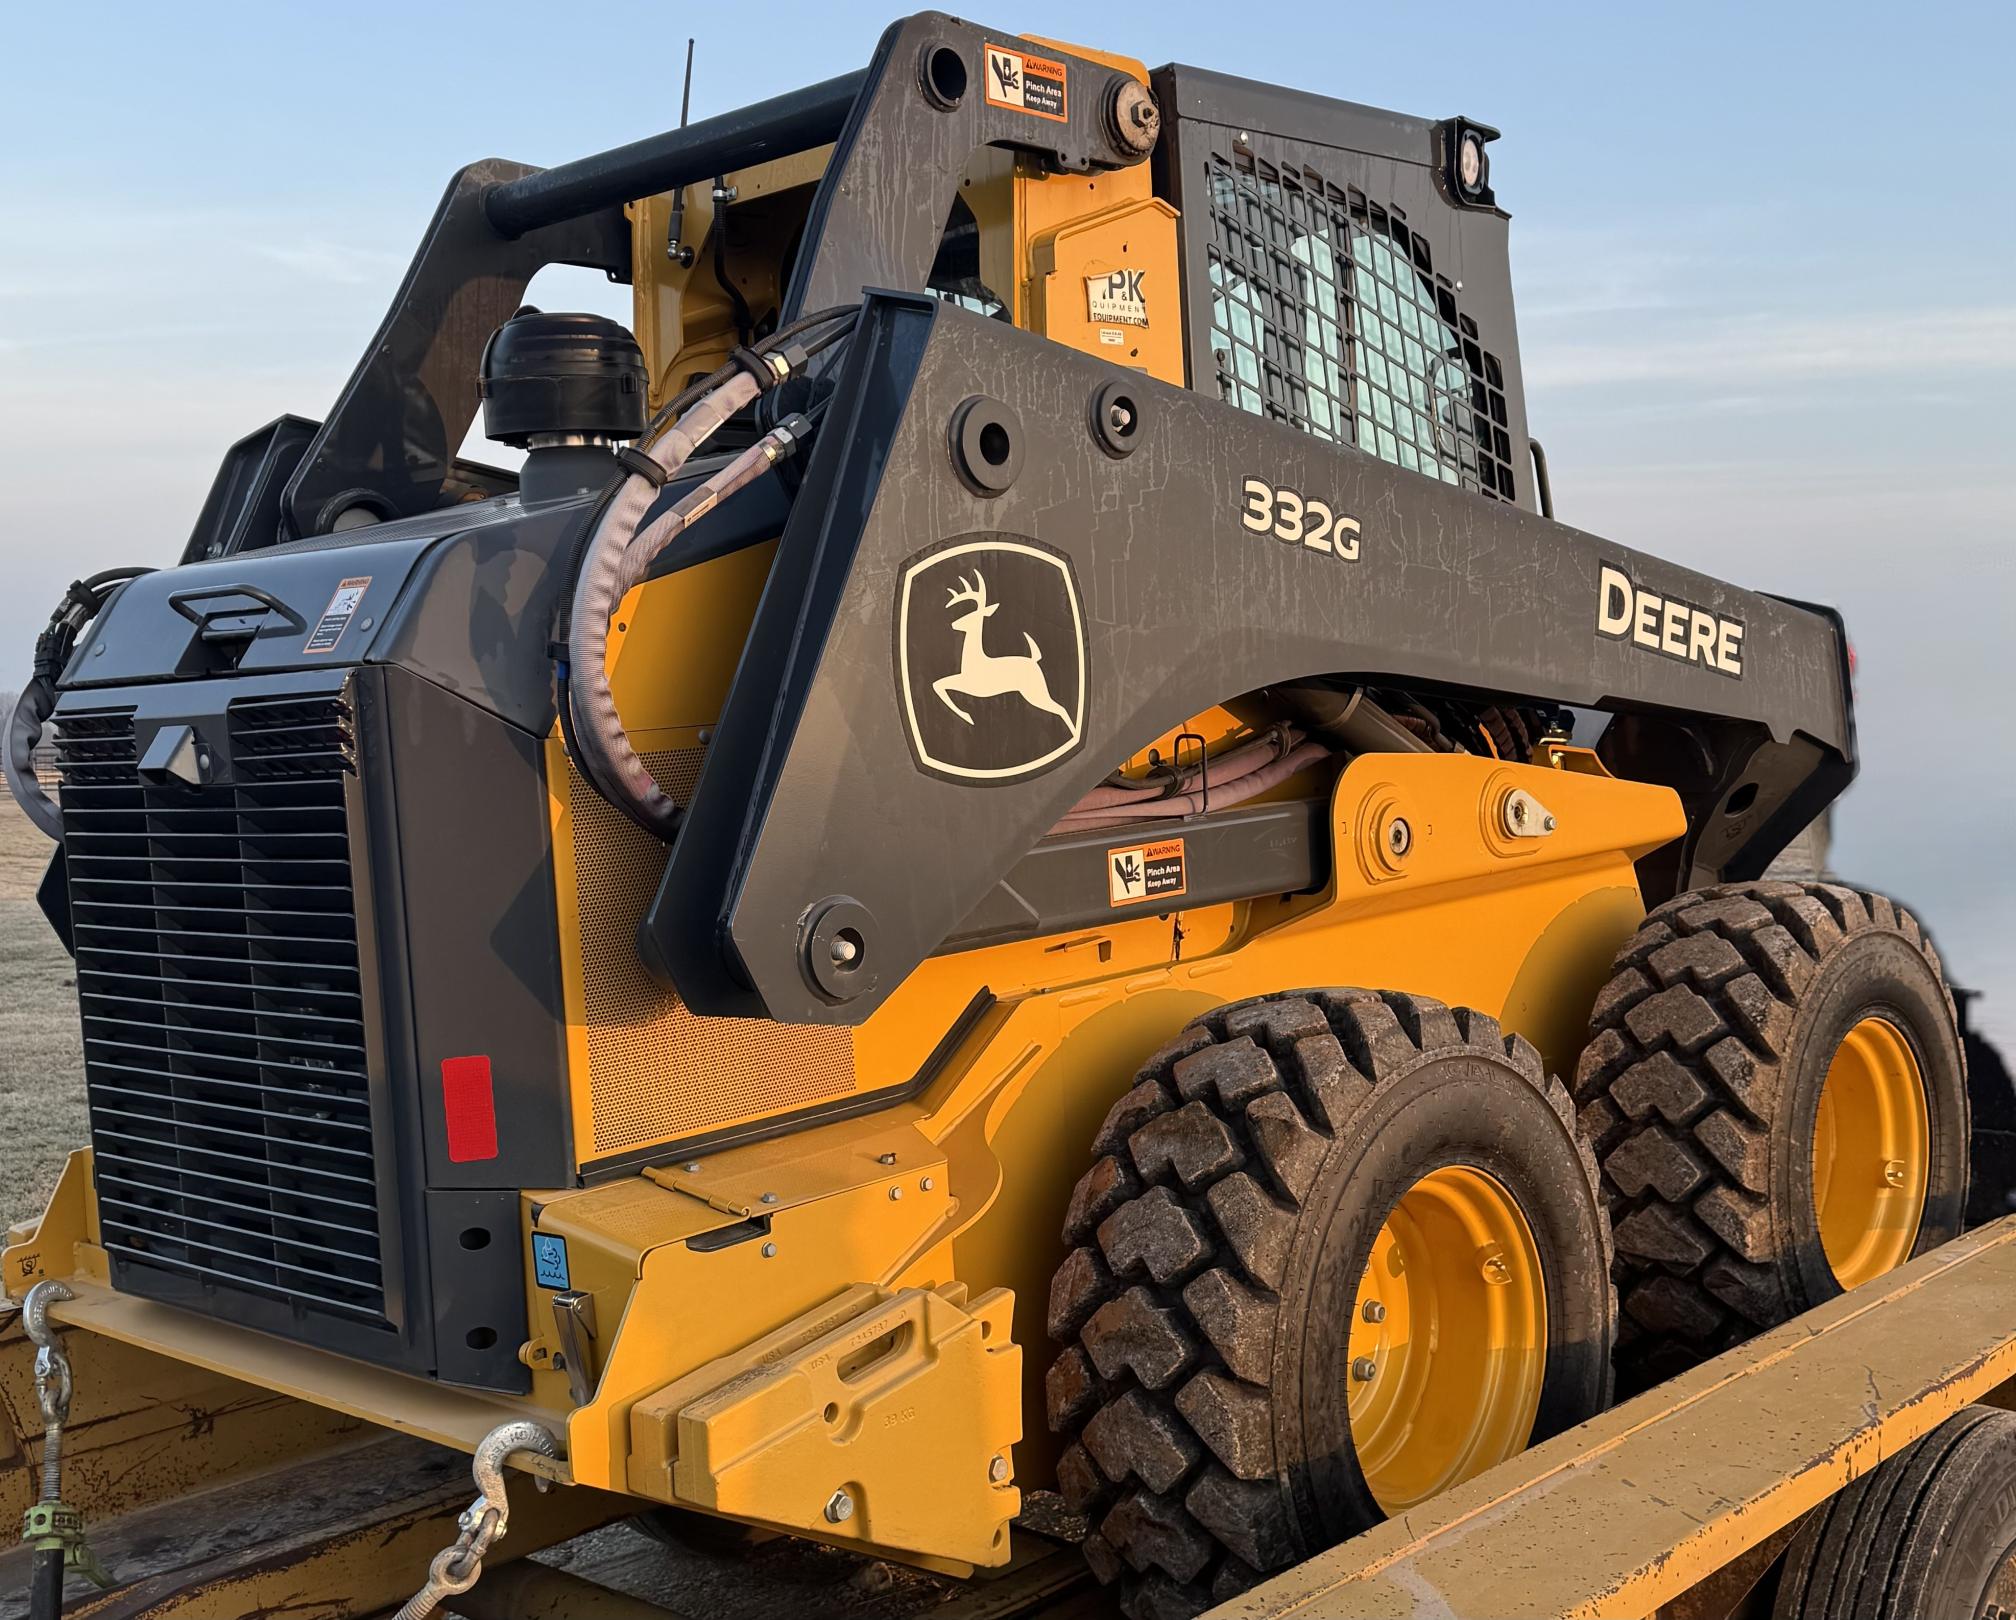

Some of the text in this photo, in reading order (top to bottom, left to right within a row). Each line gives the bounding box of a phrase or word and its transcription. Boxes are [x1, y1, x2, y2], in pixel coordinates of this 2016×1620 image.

[1032, 63, 1062, 76] WARNING
[1026, 81, 1062, 97] Pinch Area
[1026, 94, 1057, 109] Keep Away
[1242, 479, 1361, 561] 332G
[1598, 566, 1743, 675] DEERE
[1153, 845, 1180, 856] WARNING
[1147, 865, 1180, 877] Pinch Area
[1148, 877, 1176, 888] Keep Away
